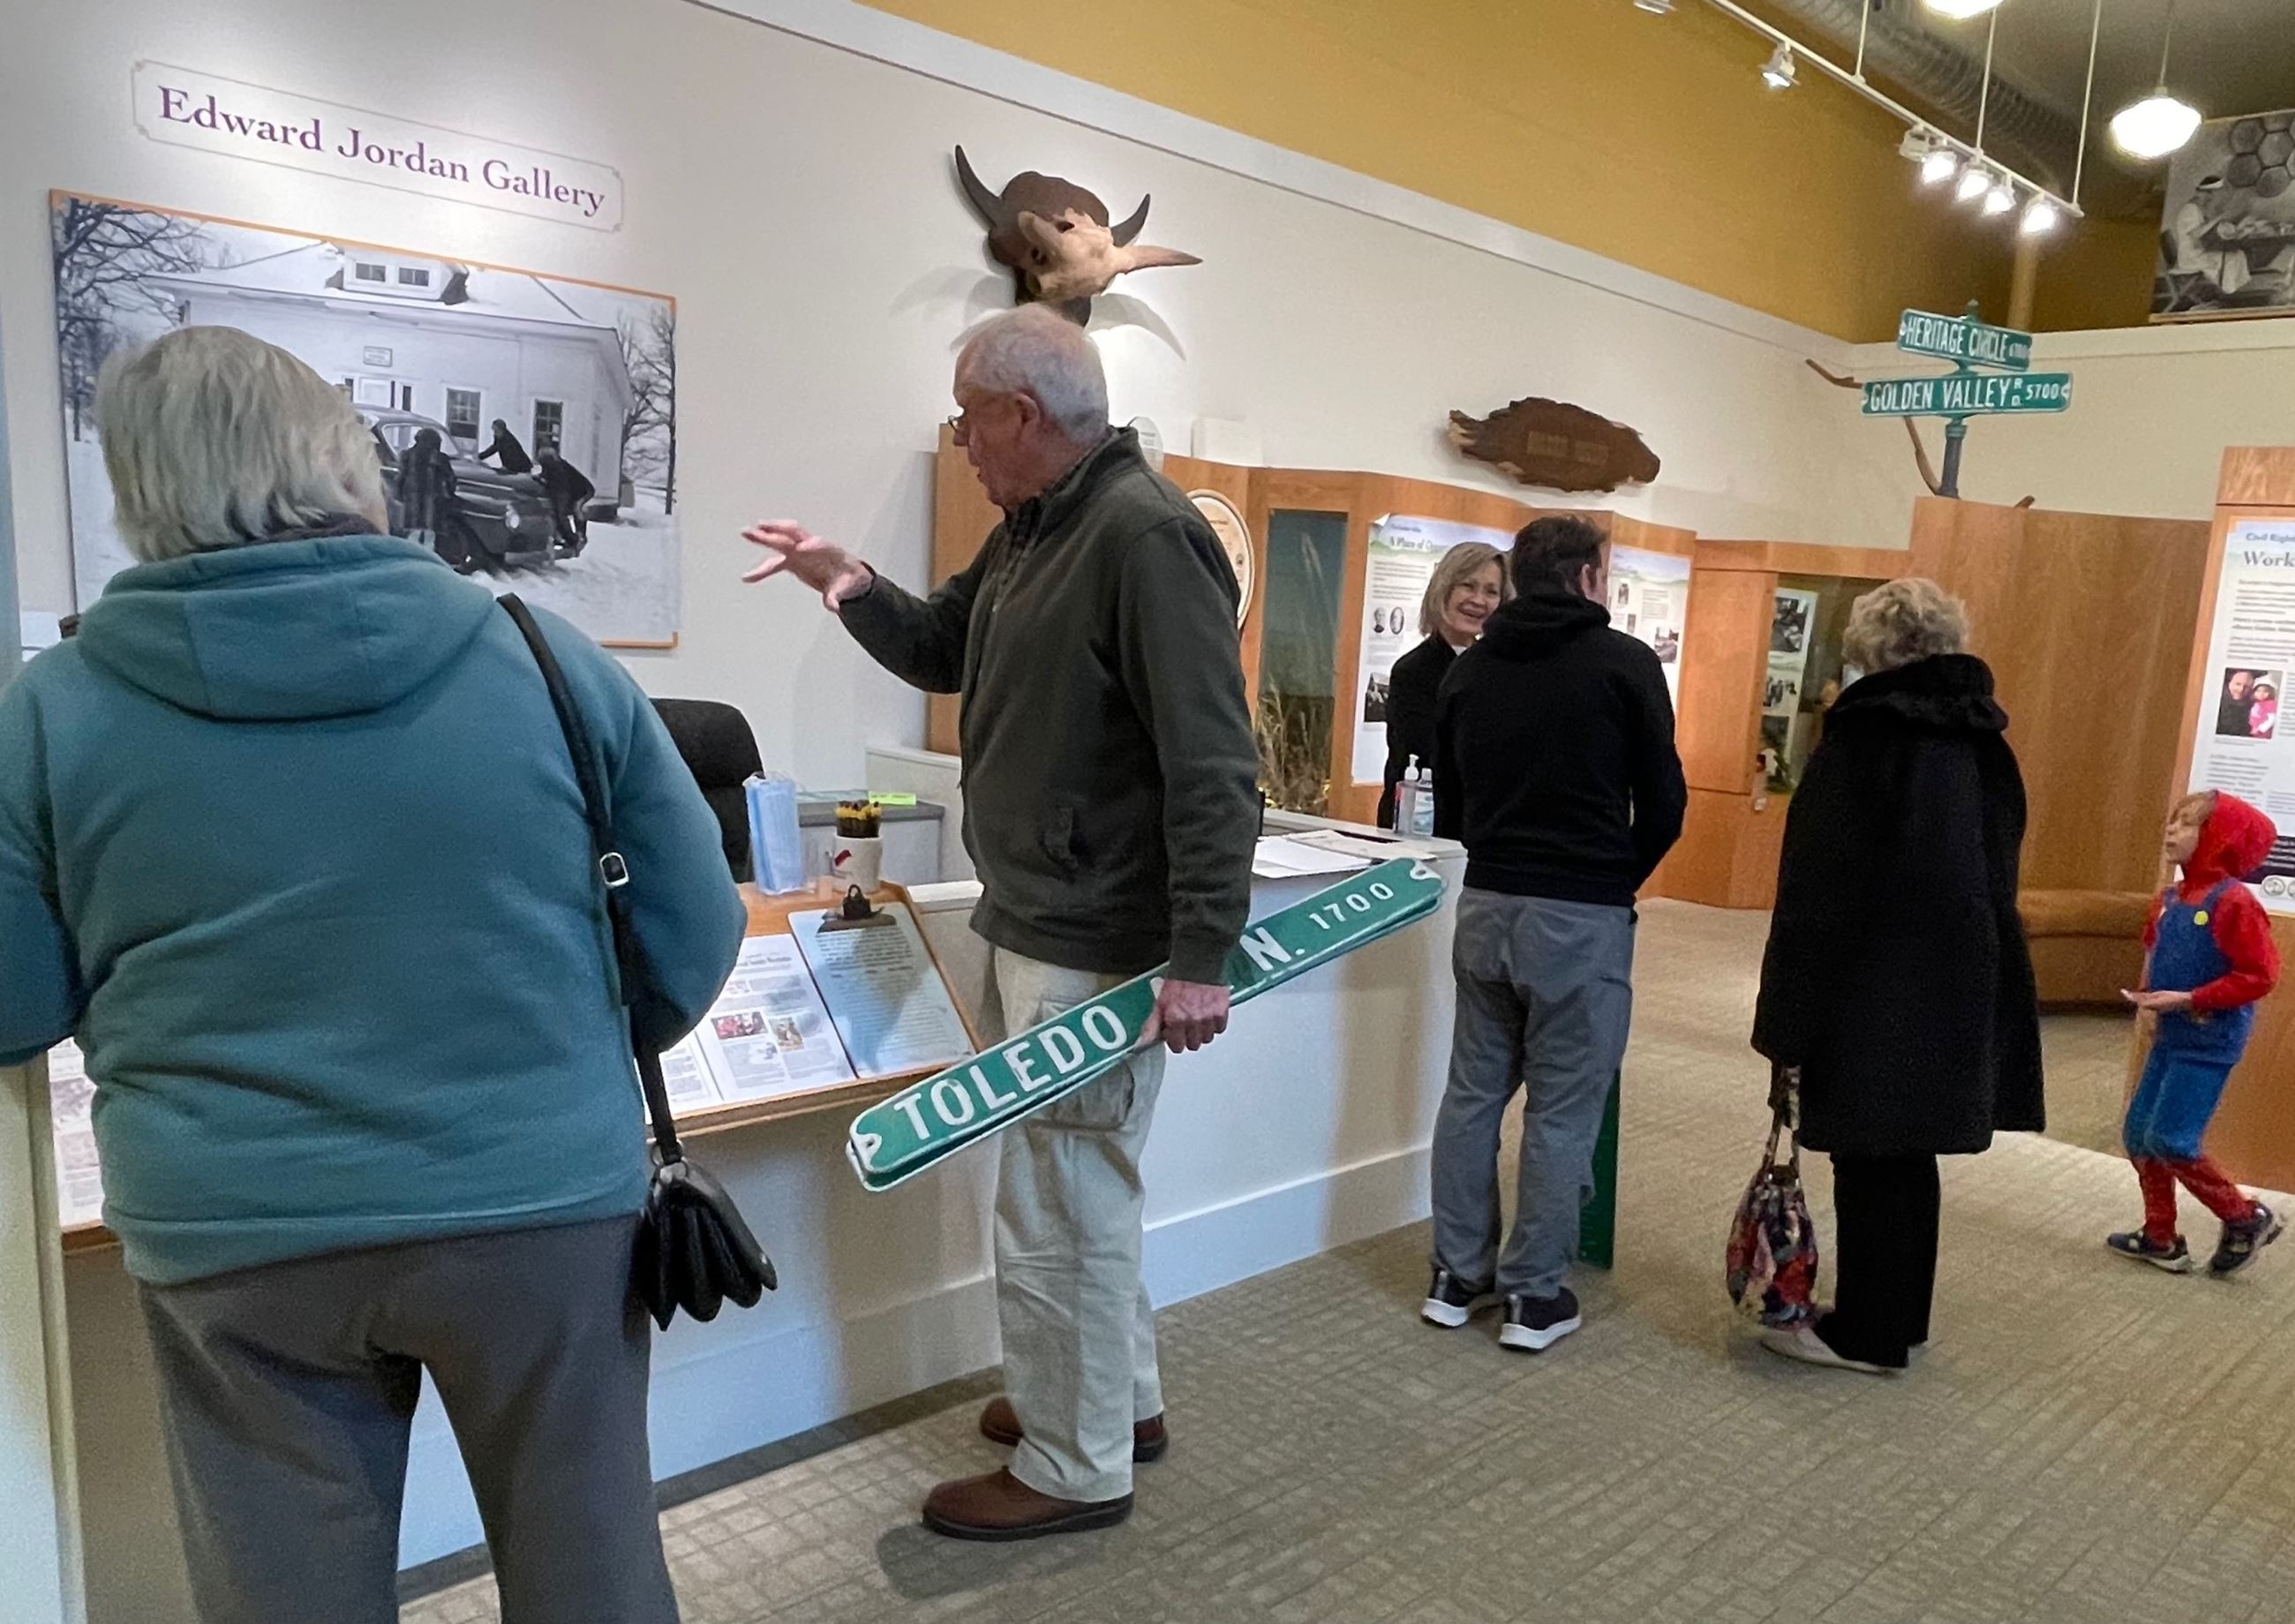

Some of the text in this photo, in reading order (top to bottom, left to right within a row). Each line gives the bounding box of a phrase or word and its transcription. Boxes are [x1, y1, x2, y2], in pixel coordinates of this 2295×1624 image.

[158, 86, 606, 217] Edward Jordan Gallery
[1905, 315, 1967, 354] HERITAGE
[1968, 327, 2009, 362] CIRCLE
[1870, 382, 1934, 410] GOLDEN
[1942, 378, 2012, 409] VALLEY
[2025, 382, 2059, 401] 5700
[894, 1004, 1128, 1140] TOLEDO
[1238, 926, 1306, 972] N.
[1308, 883, 1395, 930] 1700
